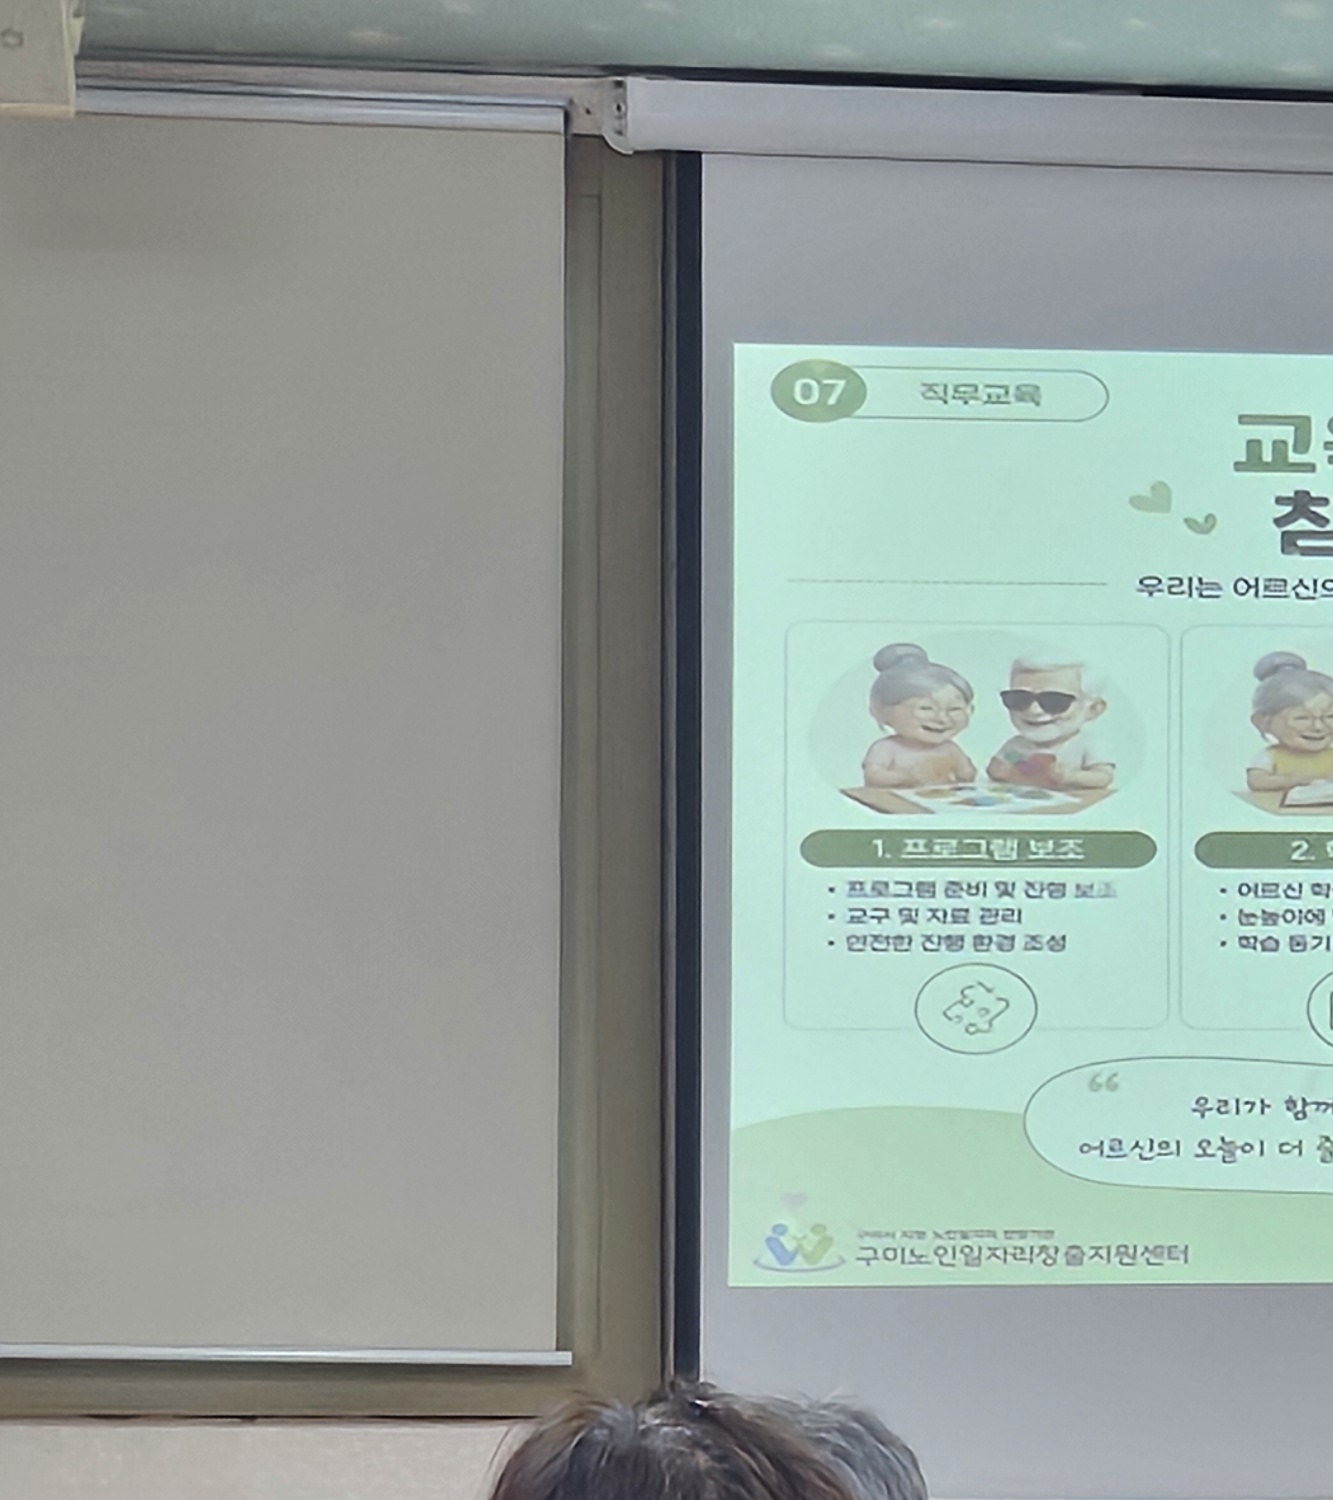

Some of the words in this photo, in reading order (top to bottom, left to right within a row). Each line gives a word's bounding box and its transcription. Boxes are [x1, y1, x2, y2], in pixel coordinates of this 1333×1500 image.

[793, 377, 846, 406] 07
[919, 381, 1044, 407] 직무교육
[1135, 575, 1224, 599] 우리는
[871, 838, 892, 859] 1.
[901, 838, 1020, 861] 프로그램
[1027, 839, 1085, 861] 보조
[1290, 839, 1316, 862] 2.
[1238, 882, 1303, 900] 어르신
[926, 907, 971, 925] 자료
[1191, 1096, 1272, 1119] 우리가
[1079, 1138, 1181, 1161] 어르신의
[1194, 1136, 1265, 1164] 오늘이
[1278, 1139, 1303, 1157] 더
[856, 1244, 1189, 1267] 구미노인일자리창출지원센터
